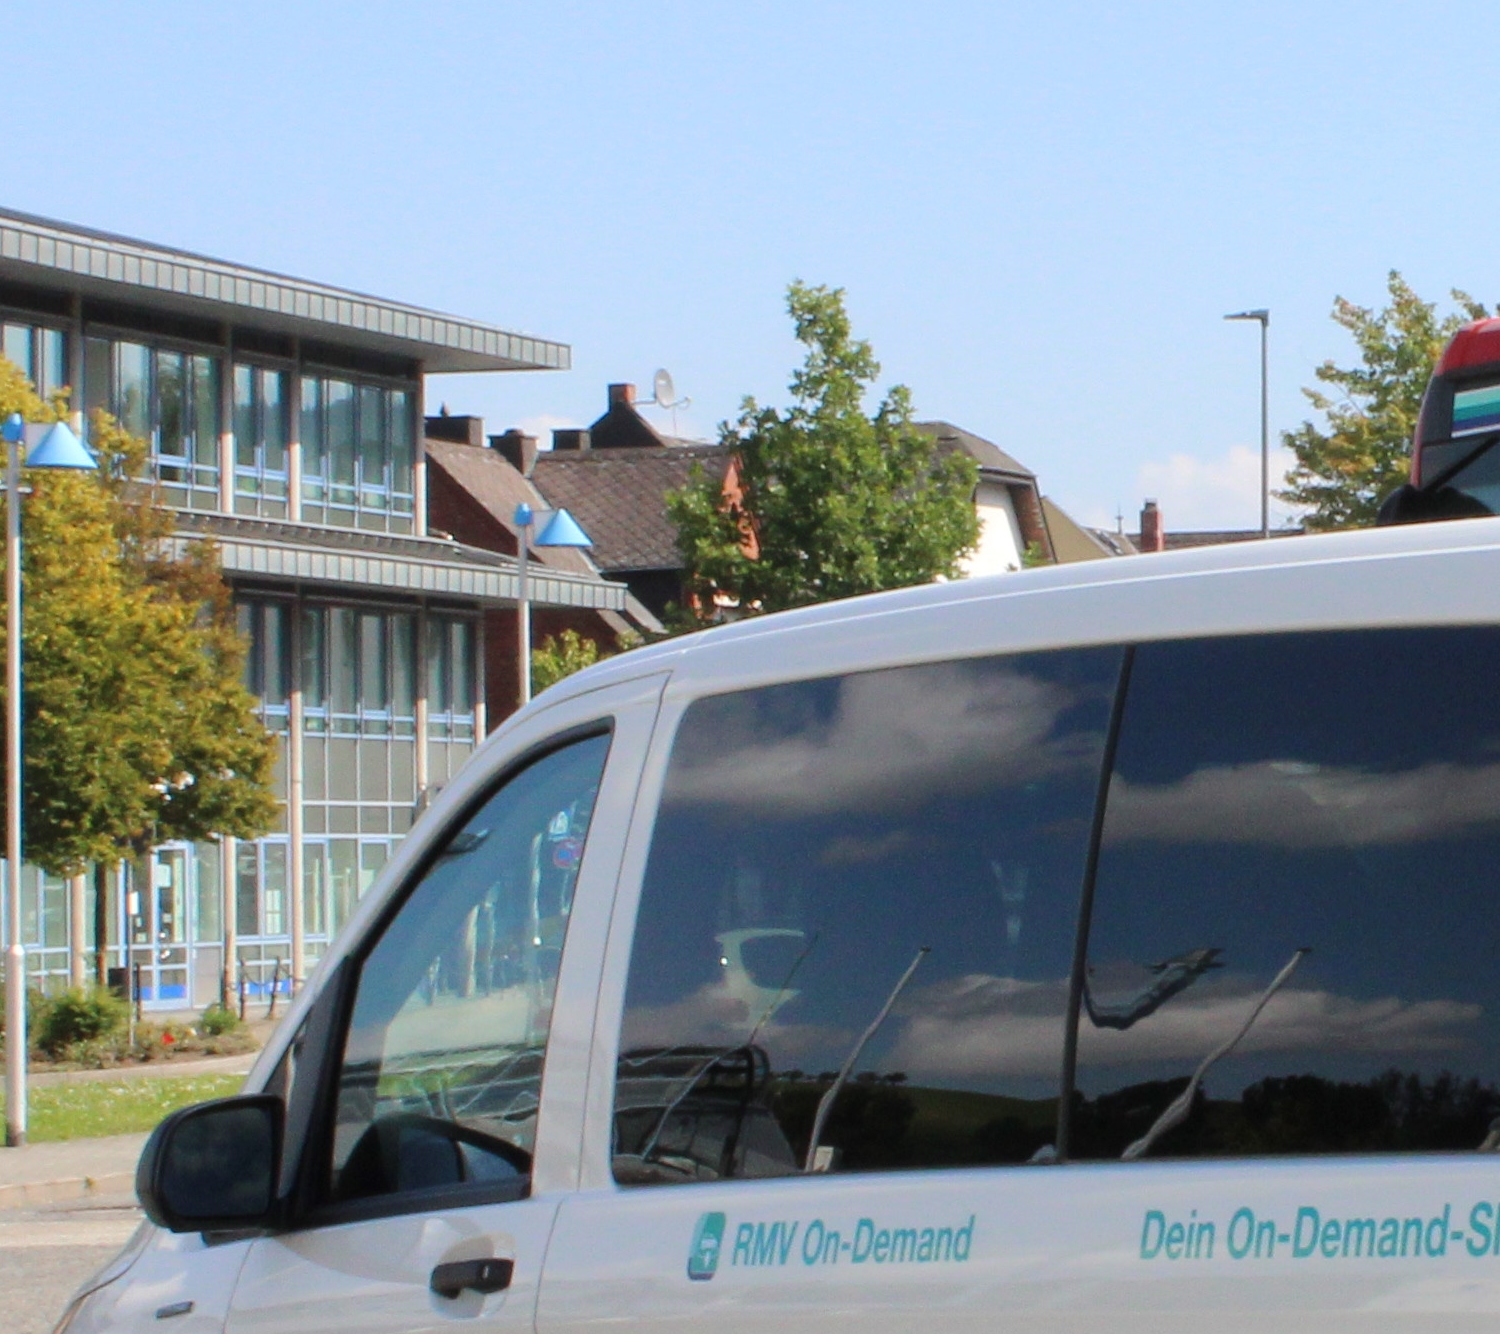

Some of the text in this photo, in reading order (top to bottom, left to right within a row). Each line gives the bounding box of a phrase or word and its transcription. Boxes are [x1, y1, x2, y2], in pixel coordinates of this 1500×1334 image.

[732, 1214, 976, 1267] RMV On-Demand
[1139, 1208, 1215, 1261] Dein
